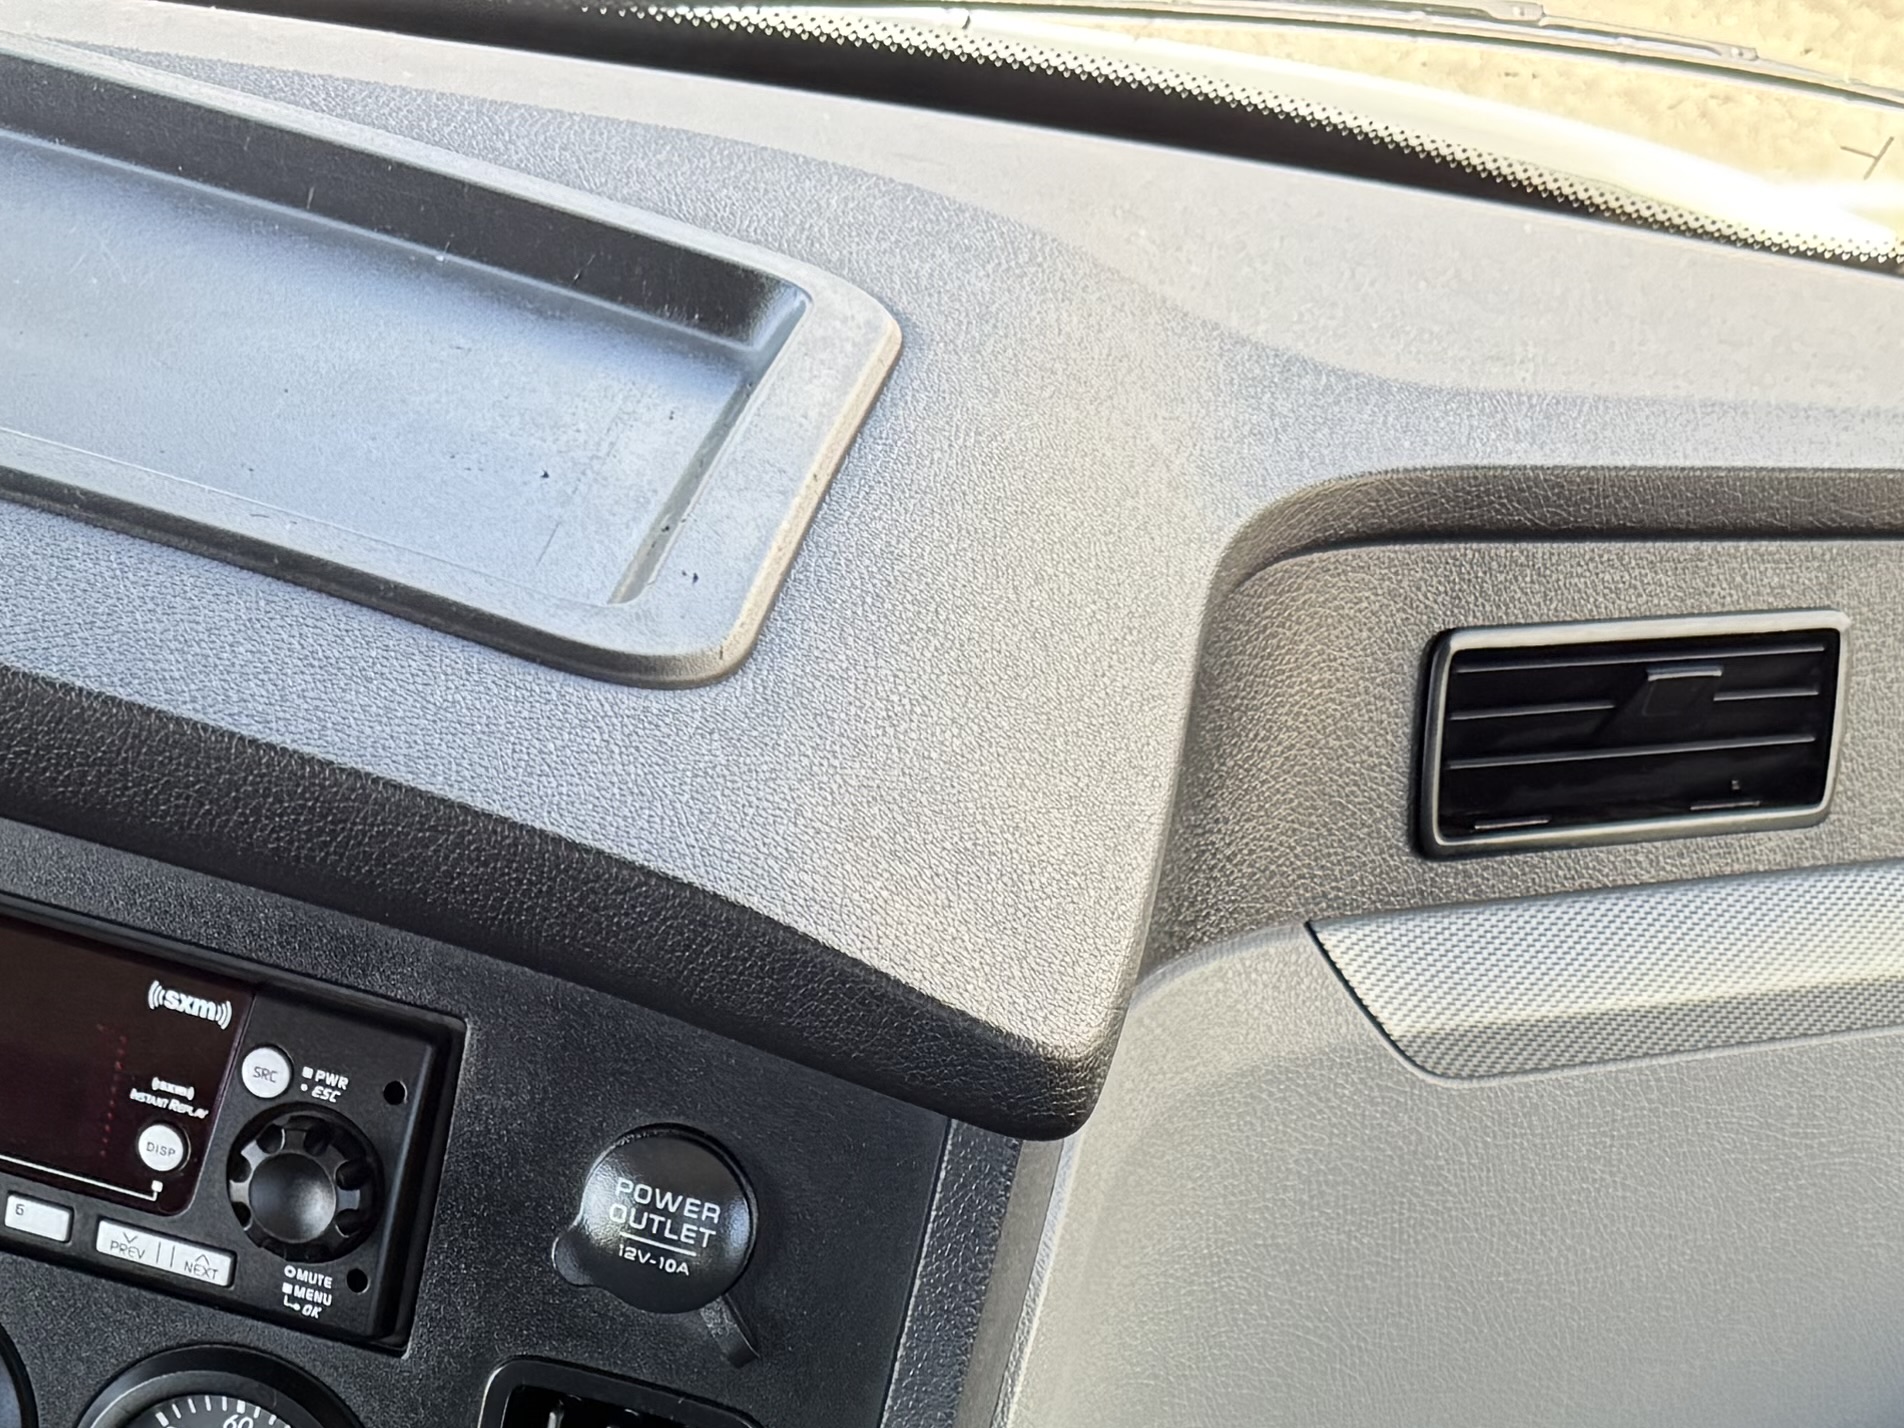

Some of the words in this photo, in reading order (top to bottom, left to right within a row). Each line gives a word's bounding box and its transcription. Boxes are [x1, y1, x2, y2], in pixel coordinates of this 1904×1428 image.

[252, 1066, 278, 1083] SRC
[315, 1069, 350, 1091] PWR
[311, 1085, 342, 1103] ESC
[146, 1142, 176, 1157] DISP
[15, 1204, 25, 1216] 6
[615, 1177, 721, 1224] POWER
[609, 1203, 716, 1248] OUTLET
[110, 1240, 146, 1260] PREV
[617, 1244, 690, 1276] 12V-10A
[183, 1261, 219, 1281] NEXT
[296, 1268, 334, 1289] MUTE
[293, 1284, 332, 1307] MENU
[301, 1303, 323, 1320] OK
